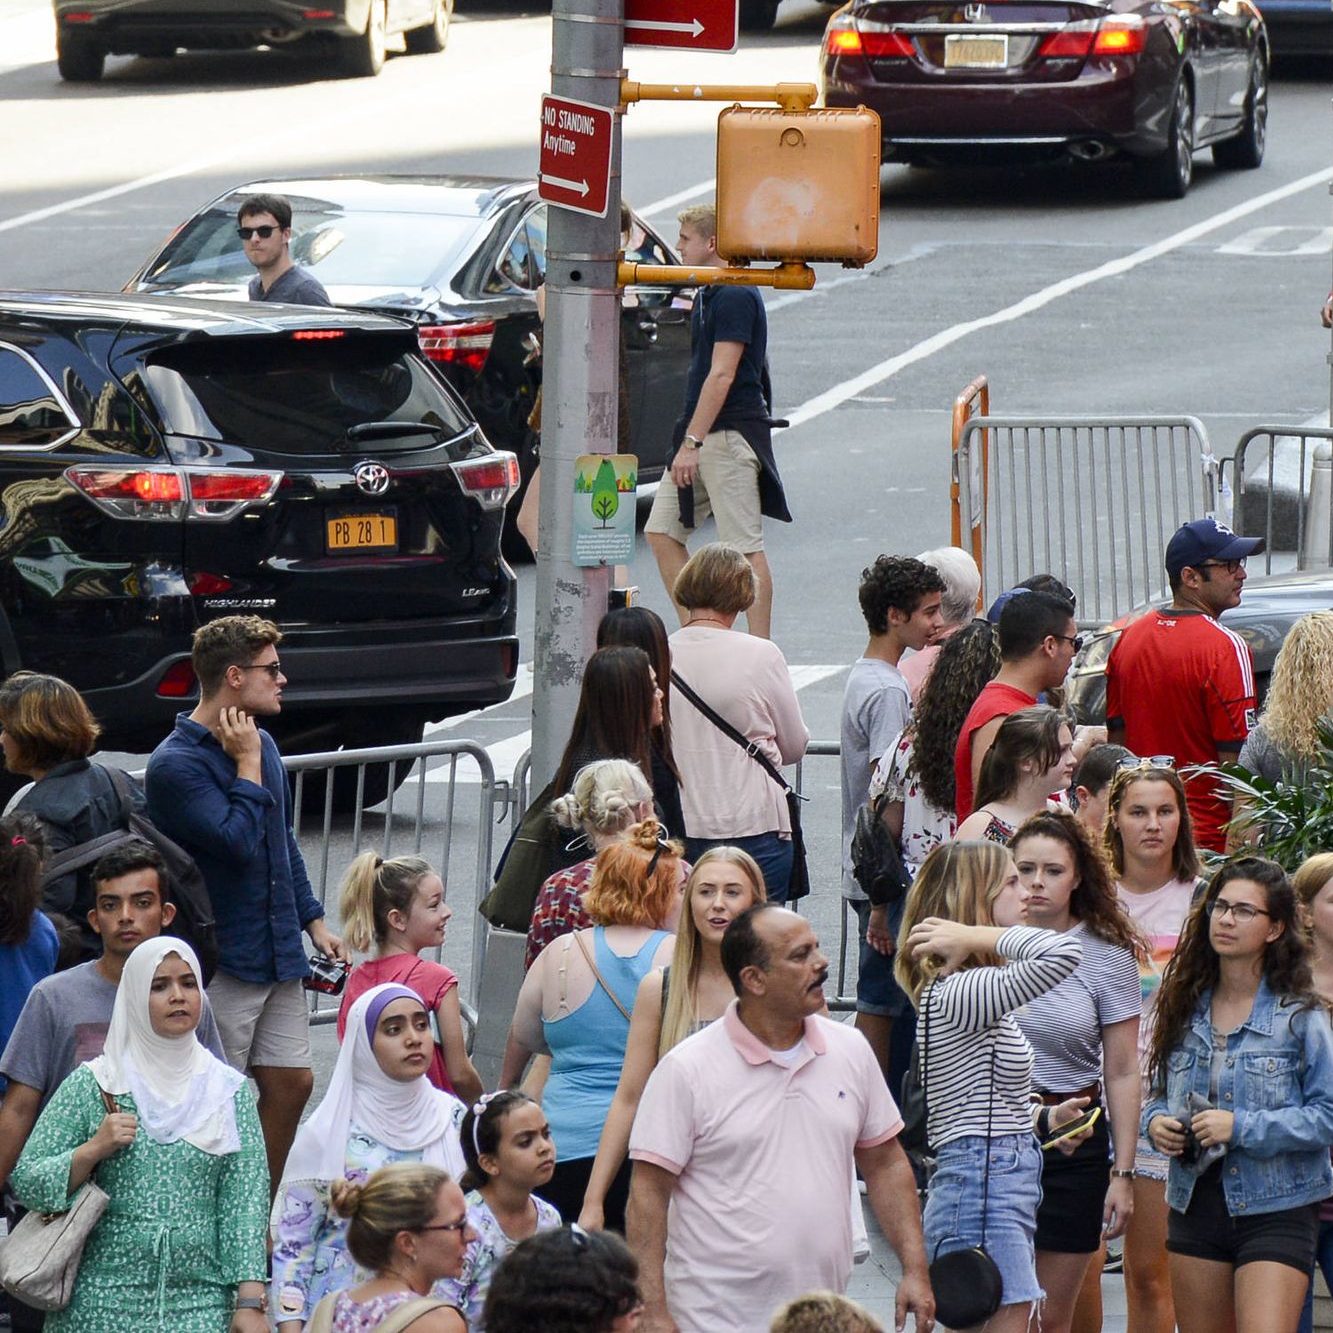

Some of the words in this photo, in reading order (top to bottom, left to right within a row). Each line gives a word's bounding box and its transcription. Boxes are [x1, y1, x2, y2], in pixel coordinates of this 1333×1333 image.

[544, 106, 557, 128] NO
[558, 109, 595, 137] STANDING
[543, 130, 576, 156] Anytime
[334, 521, 351, 545] PB
[357, 520, 373, 544] 28
[379, 519, 386, 543] 1
[203, 598, 277, 608] HIGHLANDER
